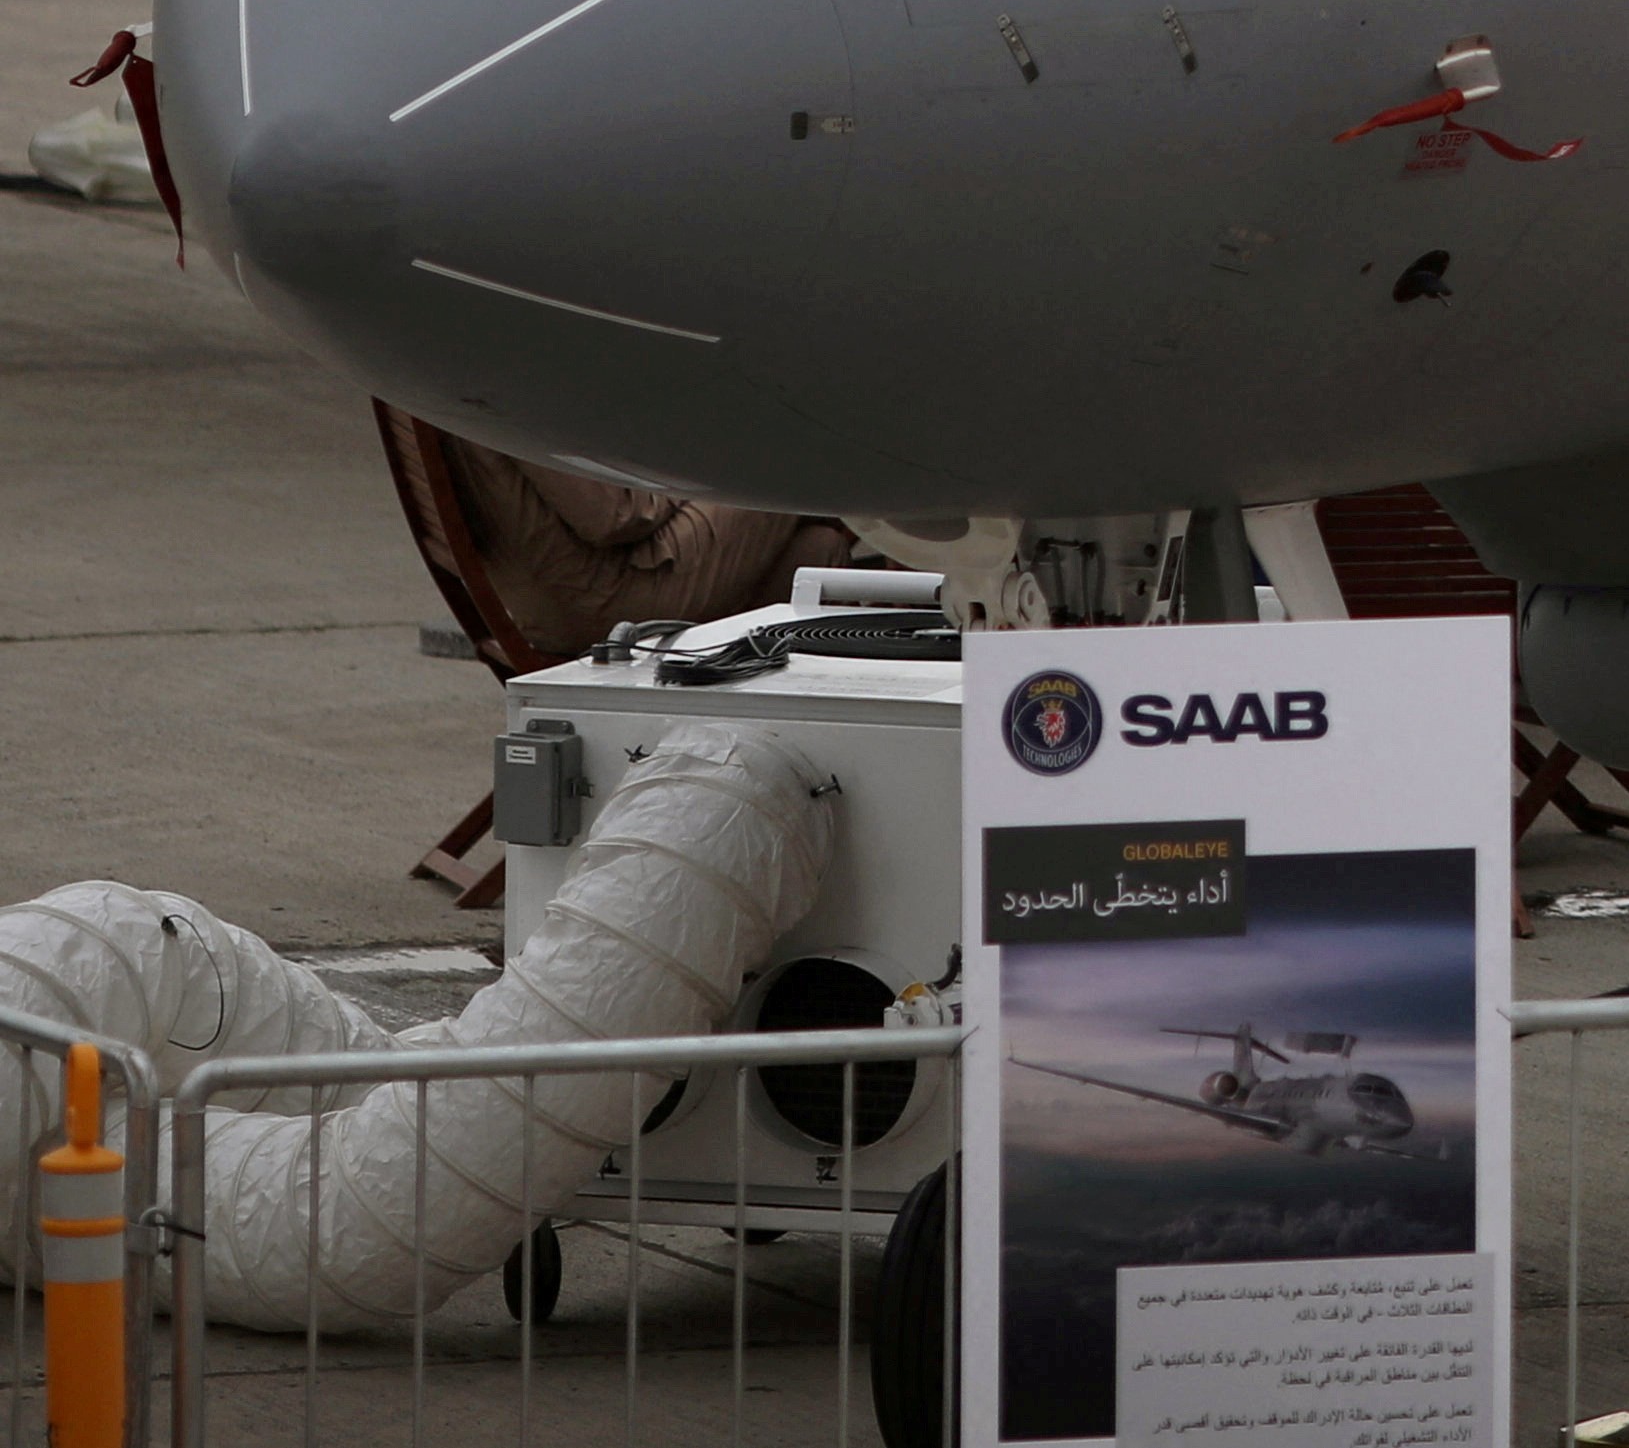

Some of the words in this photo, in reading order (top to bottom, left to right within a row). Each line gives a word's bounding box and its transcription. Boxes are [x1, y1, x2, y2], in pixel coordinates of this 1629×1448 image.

[1416, 134, 1435, 149] NO
[1437, 132, 1472, 148] STEP
[1027, 678, 1078, 700] SAAB
[1119, 689, 1330, 748] SAAB
[1021, 744, 1084, 769] TECHNOLOGIES
[1122, 841, 1230, 862] GLOBALEYE
[1001, 881, 1085, 918] الحدود
[1186, 868, 1231, 906] أداء
